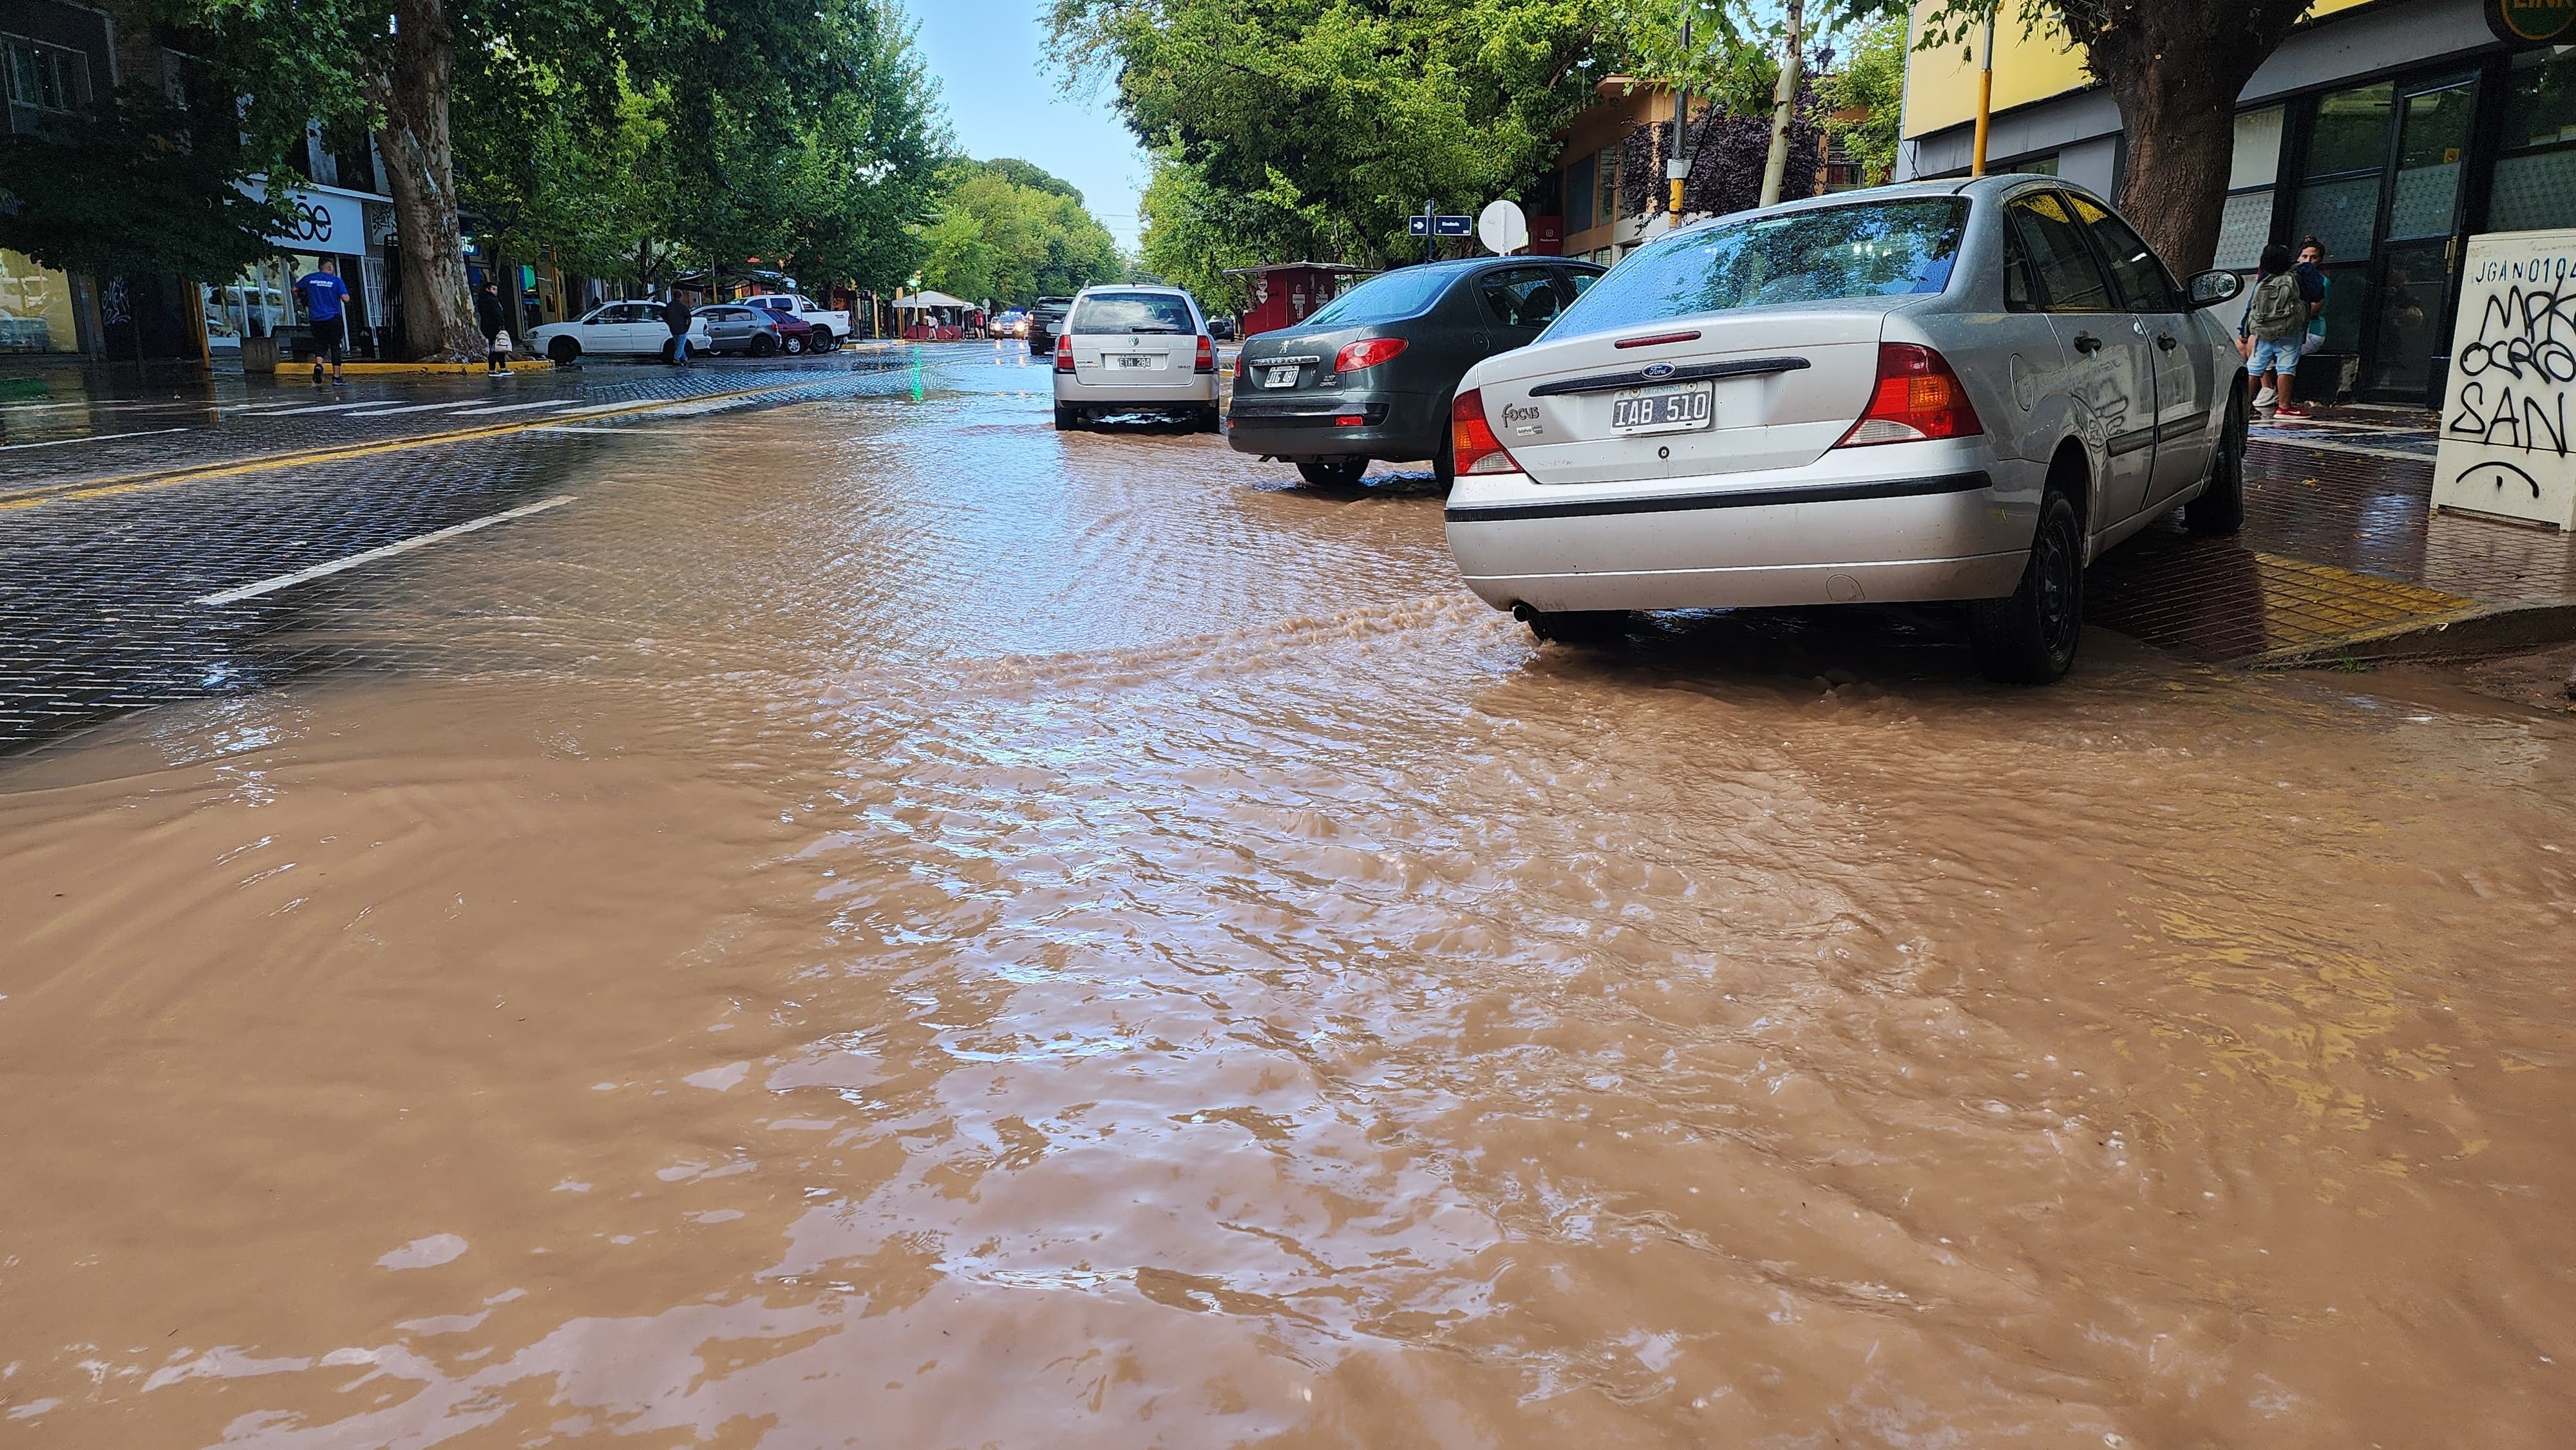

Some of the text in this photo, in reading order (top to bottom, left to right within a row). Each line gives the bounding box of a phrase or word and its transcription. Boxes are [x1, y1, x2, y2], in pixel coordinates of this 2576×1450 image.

[1119, 358, 1150, 367] ETH 284
[1649, 365, 1667, 375] Ford
[1267, 372, 1282, 383] JTG
[1643, 385, 1681, 396] ARGENTINA
[1615, 393, 1707, 426] IAB 510
[2449, 381, 2567, 458] SAN
